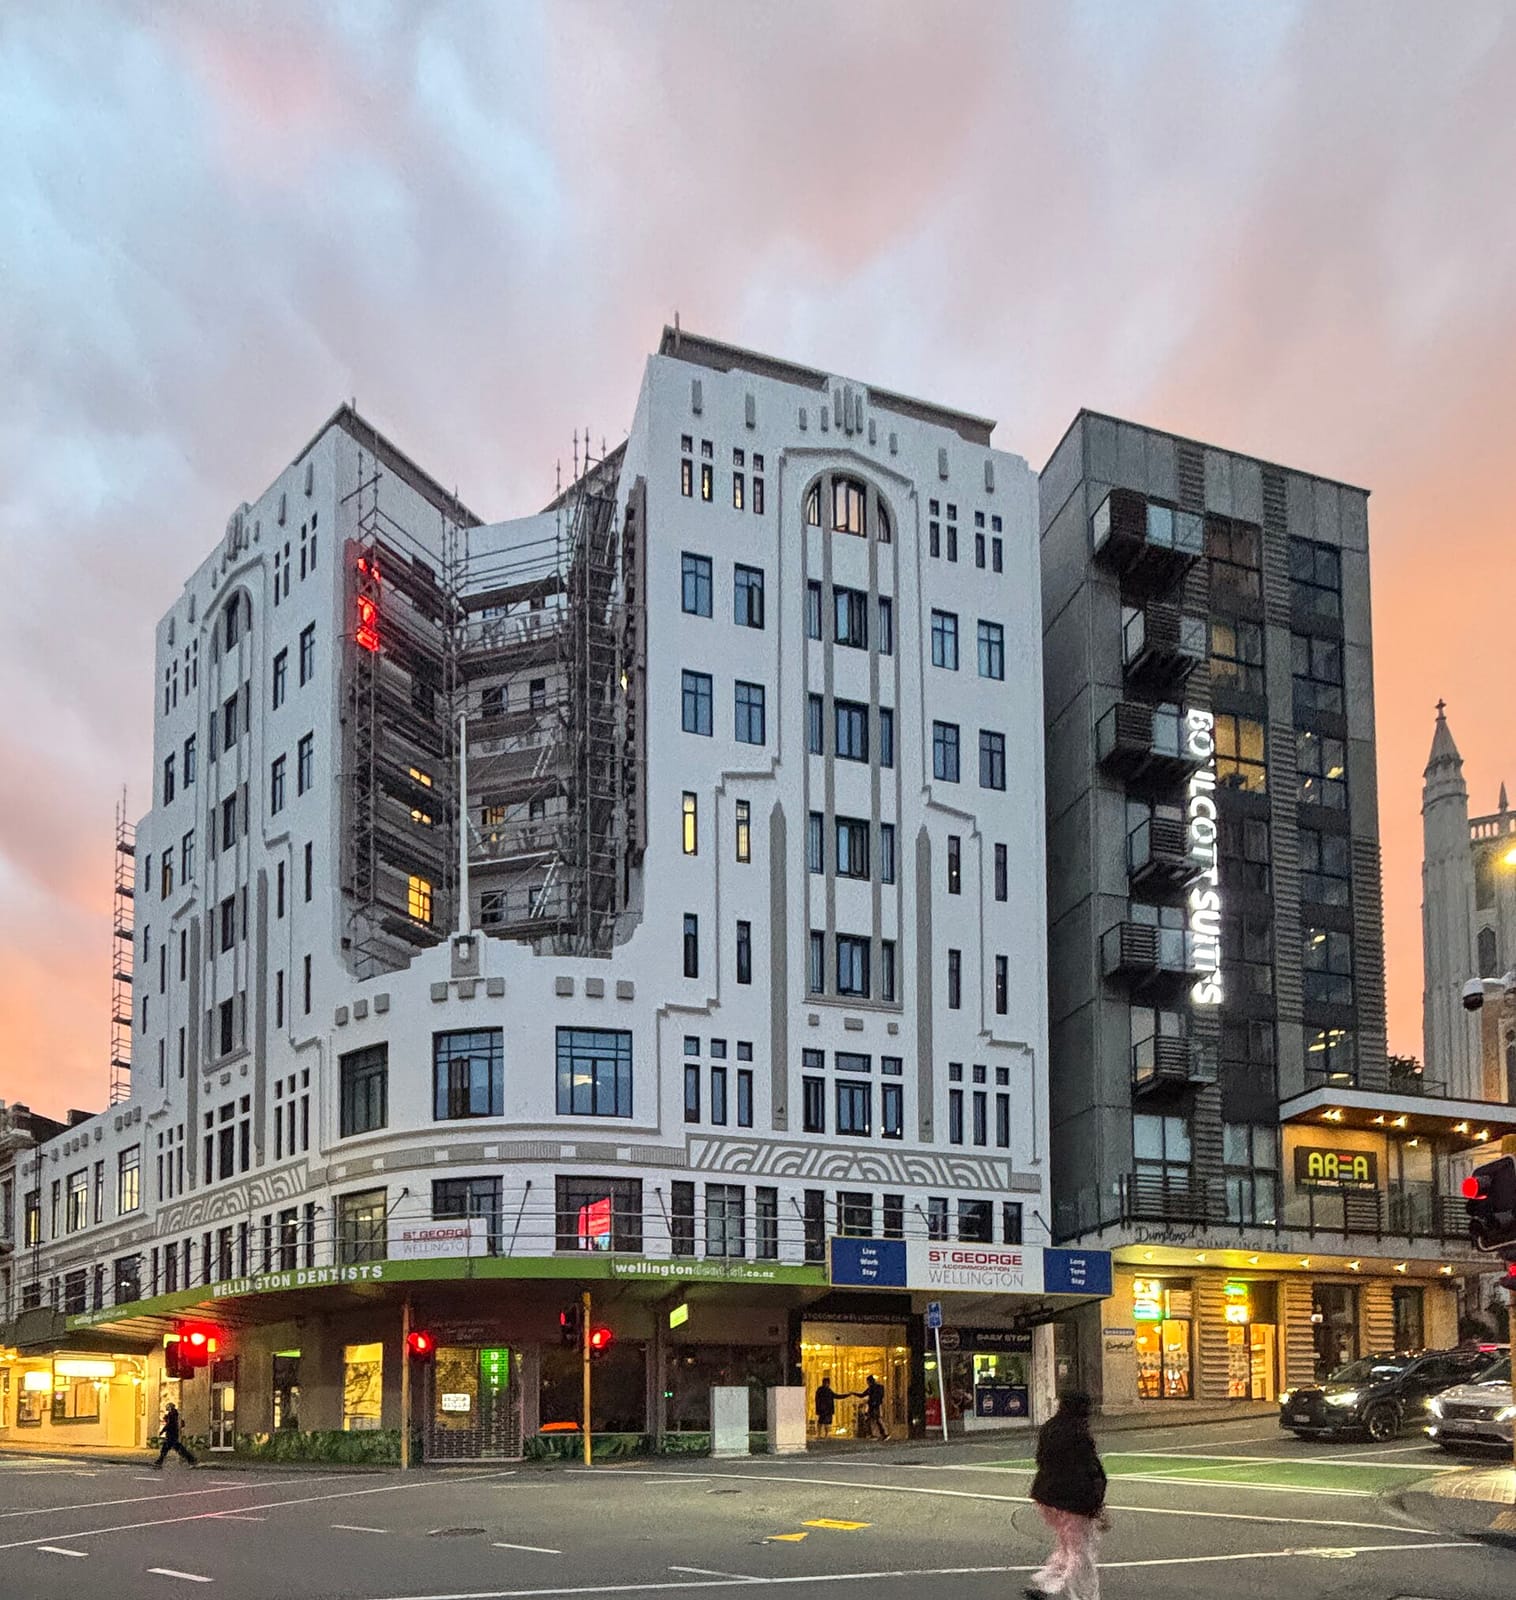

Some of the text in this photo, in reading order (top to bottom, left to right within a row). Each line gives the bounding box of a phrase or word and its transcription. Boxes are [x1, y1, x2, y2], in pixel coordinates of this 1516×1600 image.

[1308, 1152, 1369, 1180] AREA
[404, 1240, 472, 1254] WELLINGTO
[862, 1247, 876, 1255] Live
[929, 1251, 1022, 1265] ST GEORGE
[1070, 1258, 1086, 1266] Long
[862, 1268, 877, 1277] Stay
[942, 1263, 1010, 1272] ACCOMMODATION
[297, 1264, 383, 1286] DENTISTS
[928, 1269, 1024, 1287] WELLINGTON
